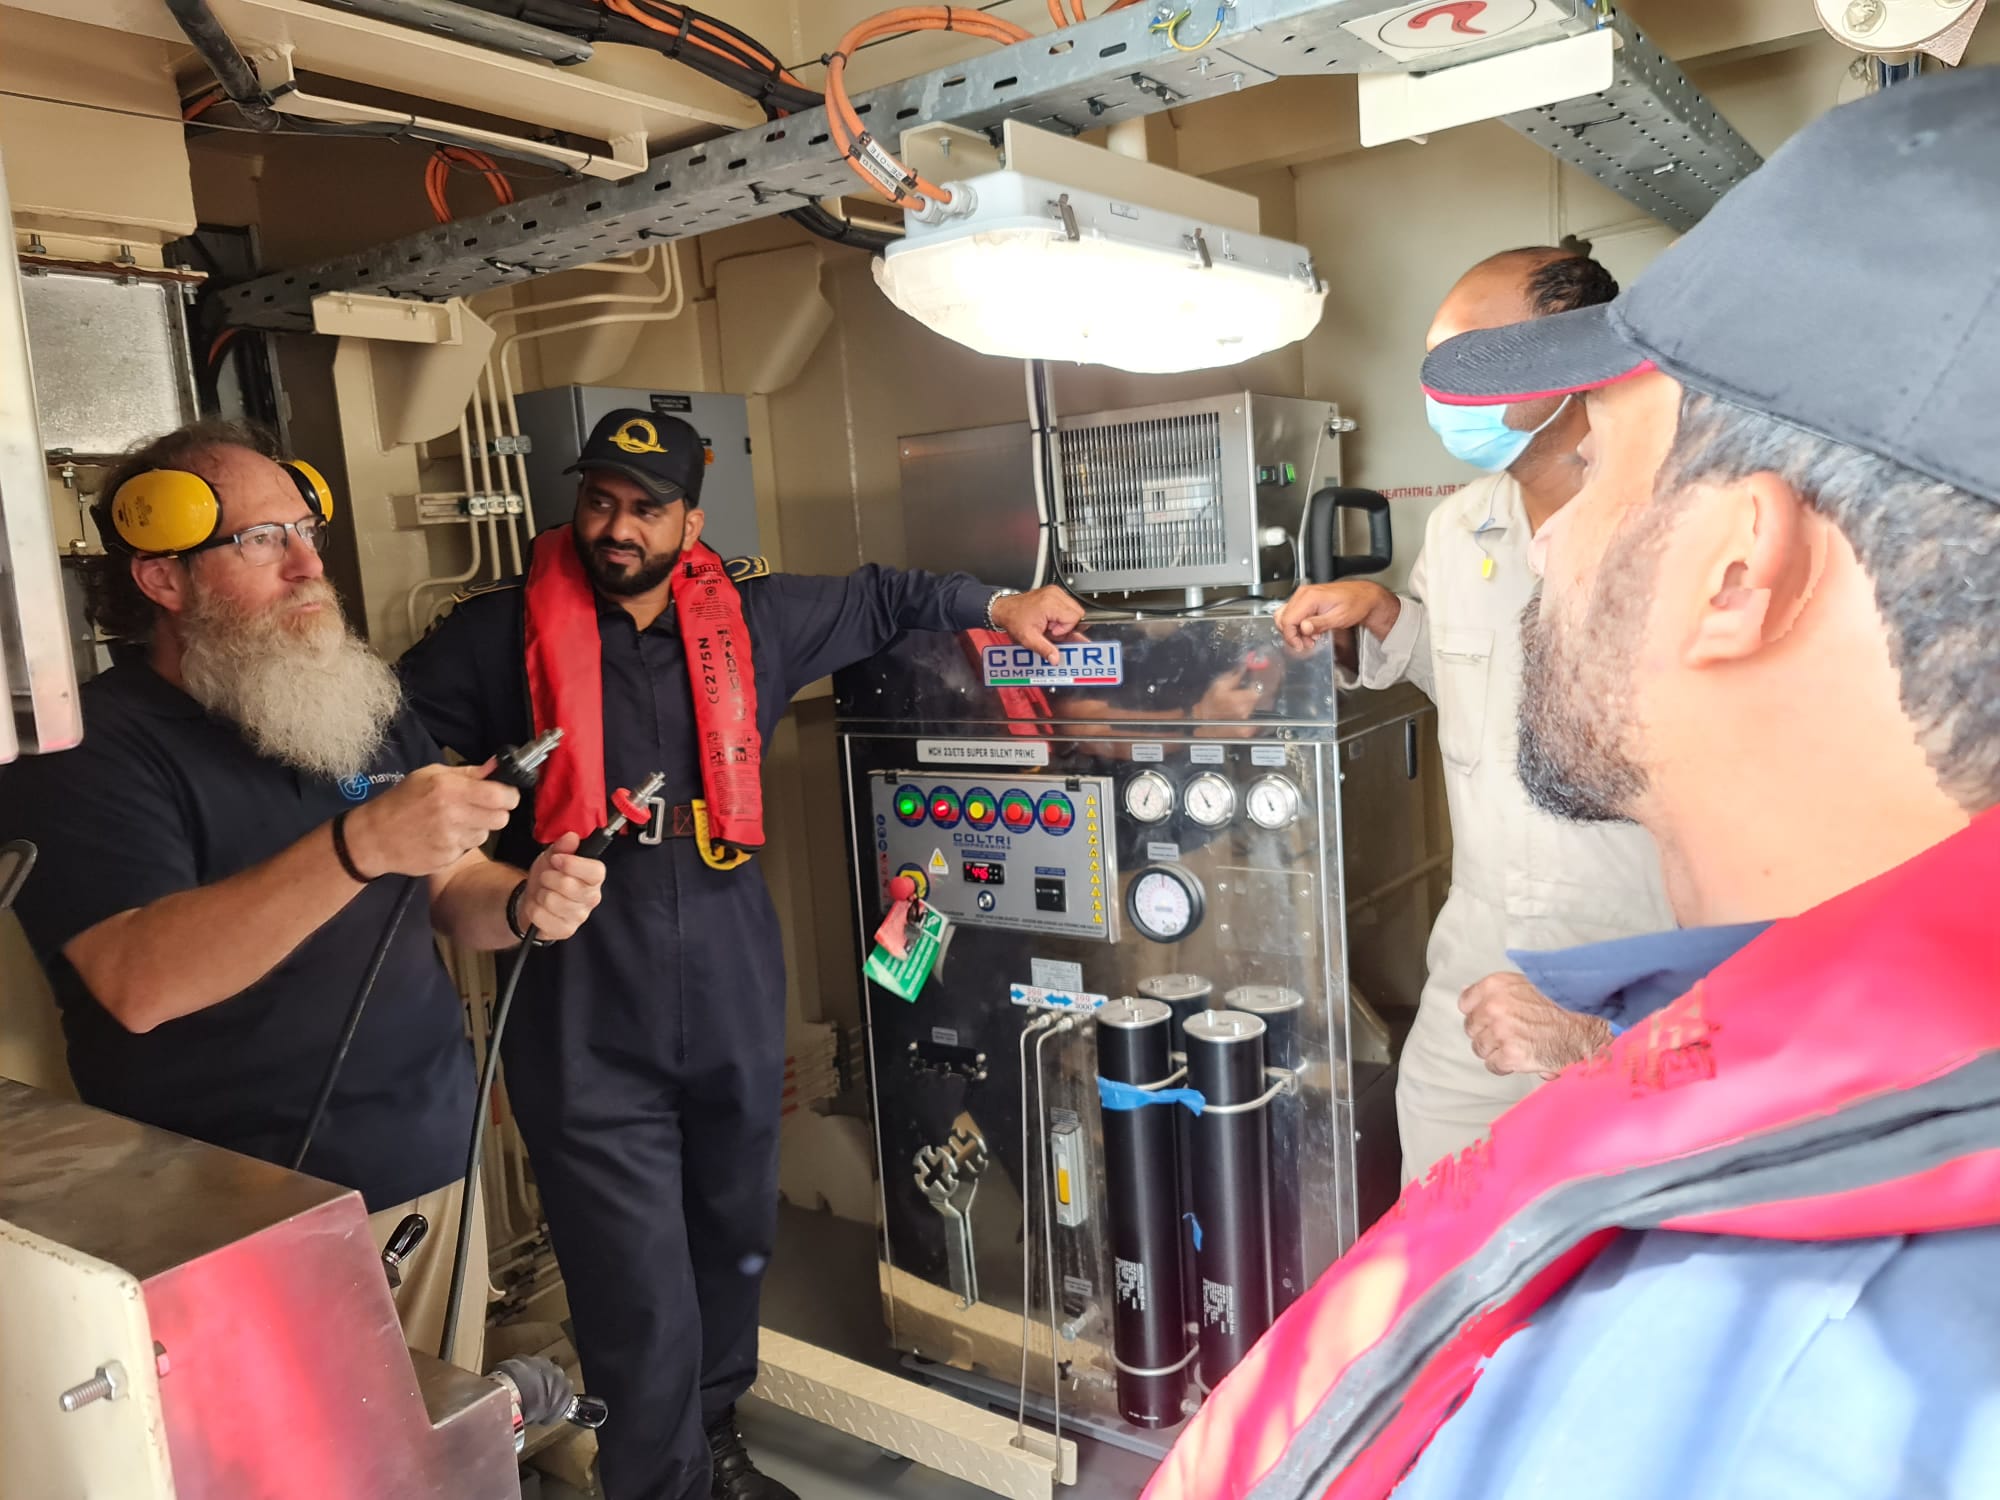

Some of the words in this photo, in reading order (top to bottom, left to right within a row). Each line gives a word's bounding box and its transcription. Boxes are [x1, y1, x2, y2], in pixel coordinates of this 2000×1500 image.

[1377, 486, 1432, 499] REATHING
[989, 668, 1117, 677] COMPRESSORS
[967, 748, 988, 758] SUPER
[990, 748, 1012, 759] SILENT
[1015, 749, 1035, 759] PRIME
[953, 833, 1011, 845] COLTRI
